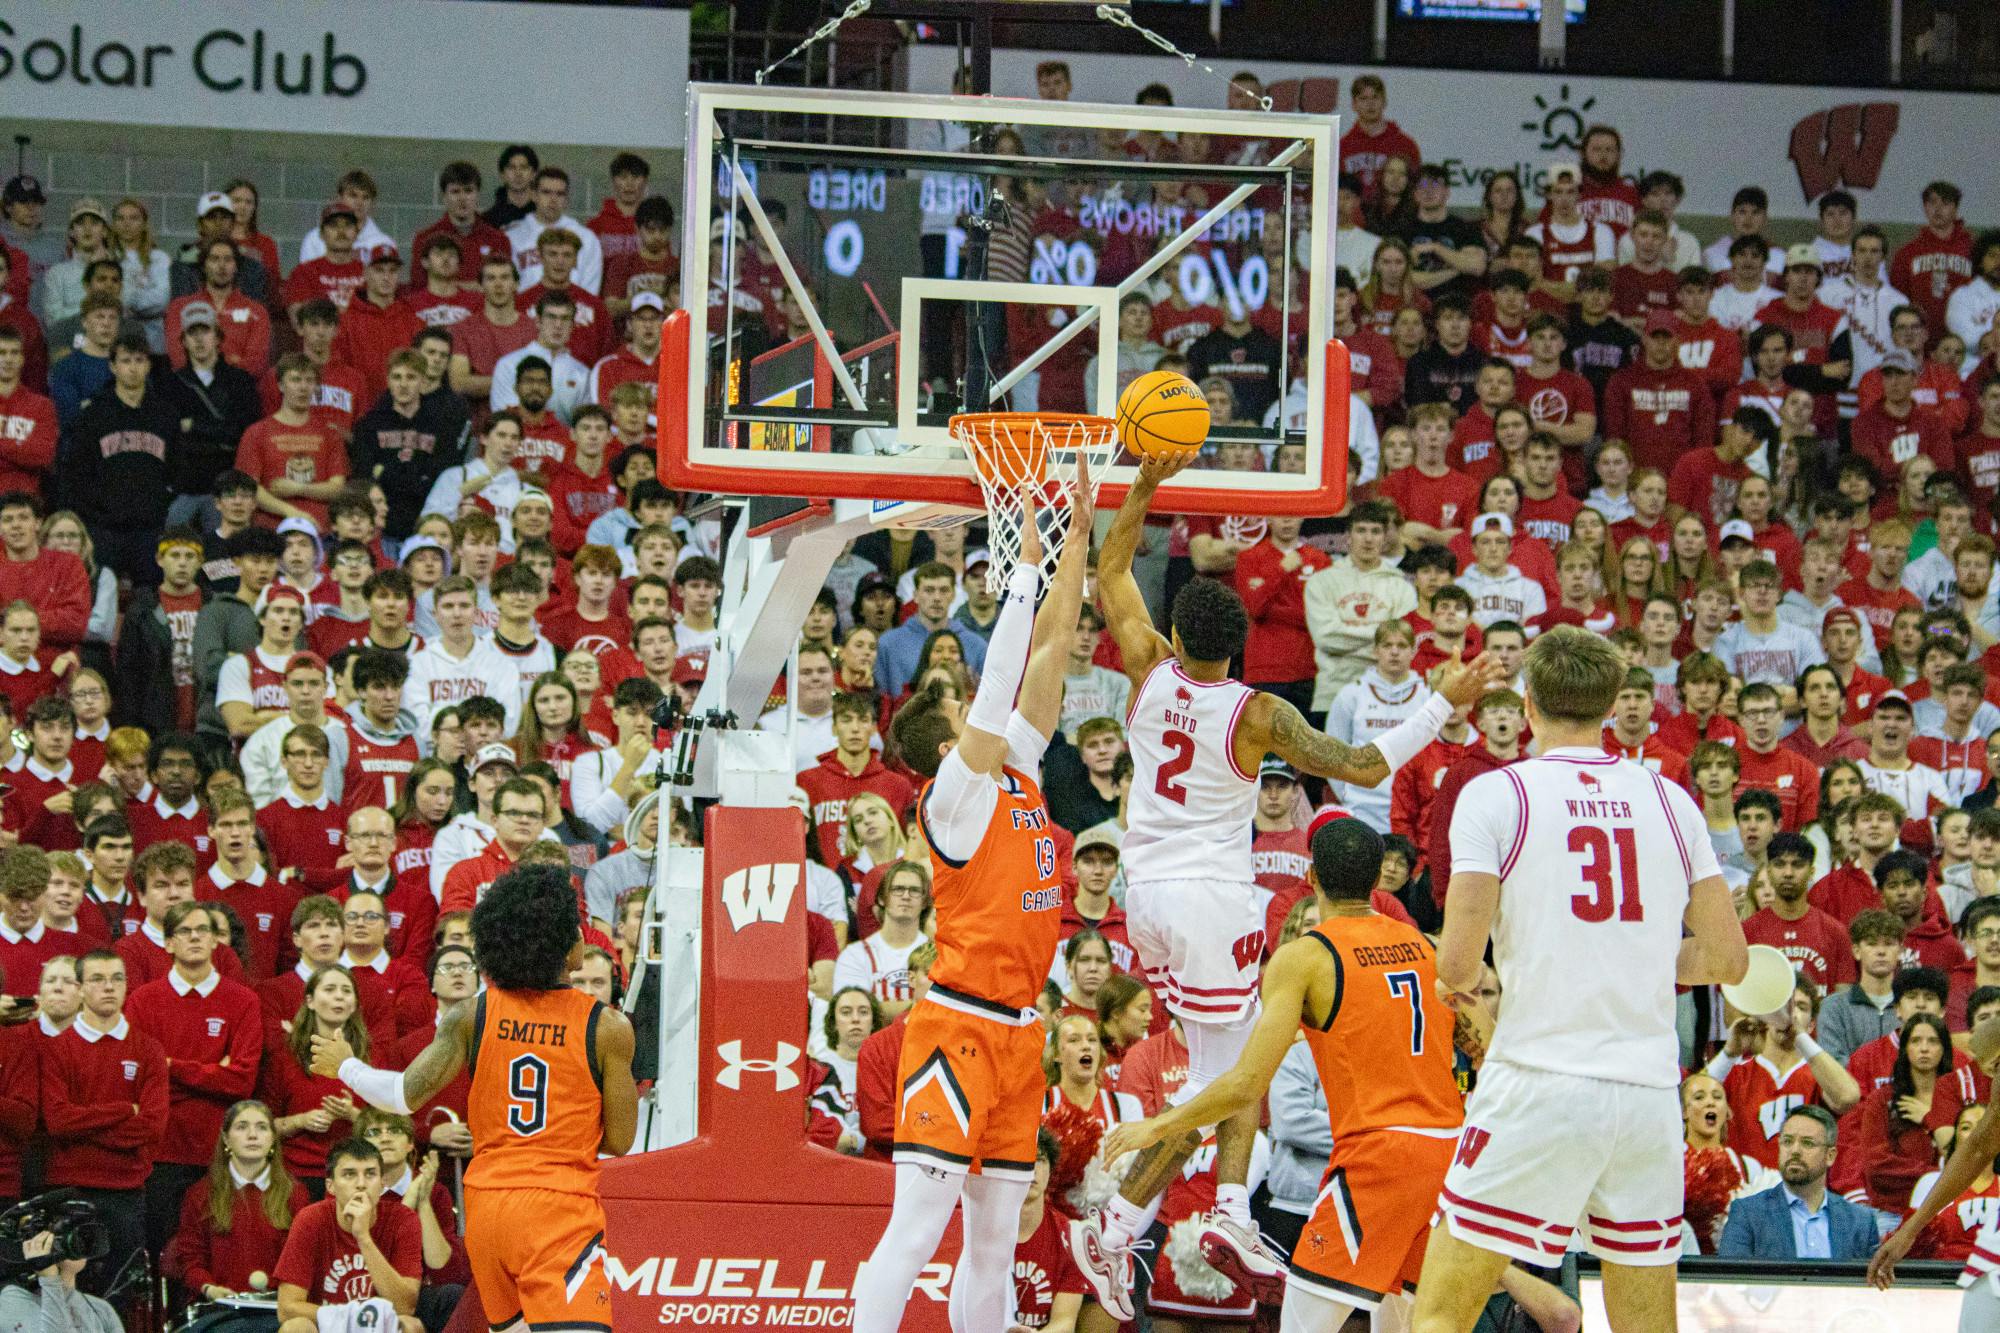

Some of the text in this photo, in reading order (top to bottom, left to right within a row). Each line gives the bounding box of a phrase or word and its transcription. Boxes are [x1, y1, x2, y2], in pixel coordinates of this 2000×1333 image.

[194, 27, 367, 97] Club
[1788, 101, 1901, 206] W
[1678, 339, 1714, 369] W
[1164, 709, 1197, 734] BOYD
[1155, 729, 1196, 806] 2
[1565, 799, 1633, 818] WINTER
[1035, 836, 1056, 880] 13
[1566, 825, 1643, 922] 31
[721, 862, 800, 935] W
[1231, 929, 1267, 972] W
[1353, 942, 1426, 967] GREGORY
[497, 1018, 567, 1047] SMITH
[1383, 969, 1423, 1056] 7
[508, 1053, 549, 1136] 9
[1455, 1126, 1493, 1170] W
[658, 1303, 855, 1327] SPORTS MEDICI
